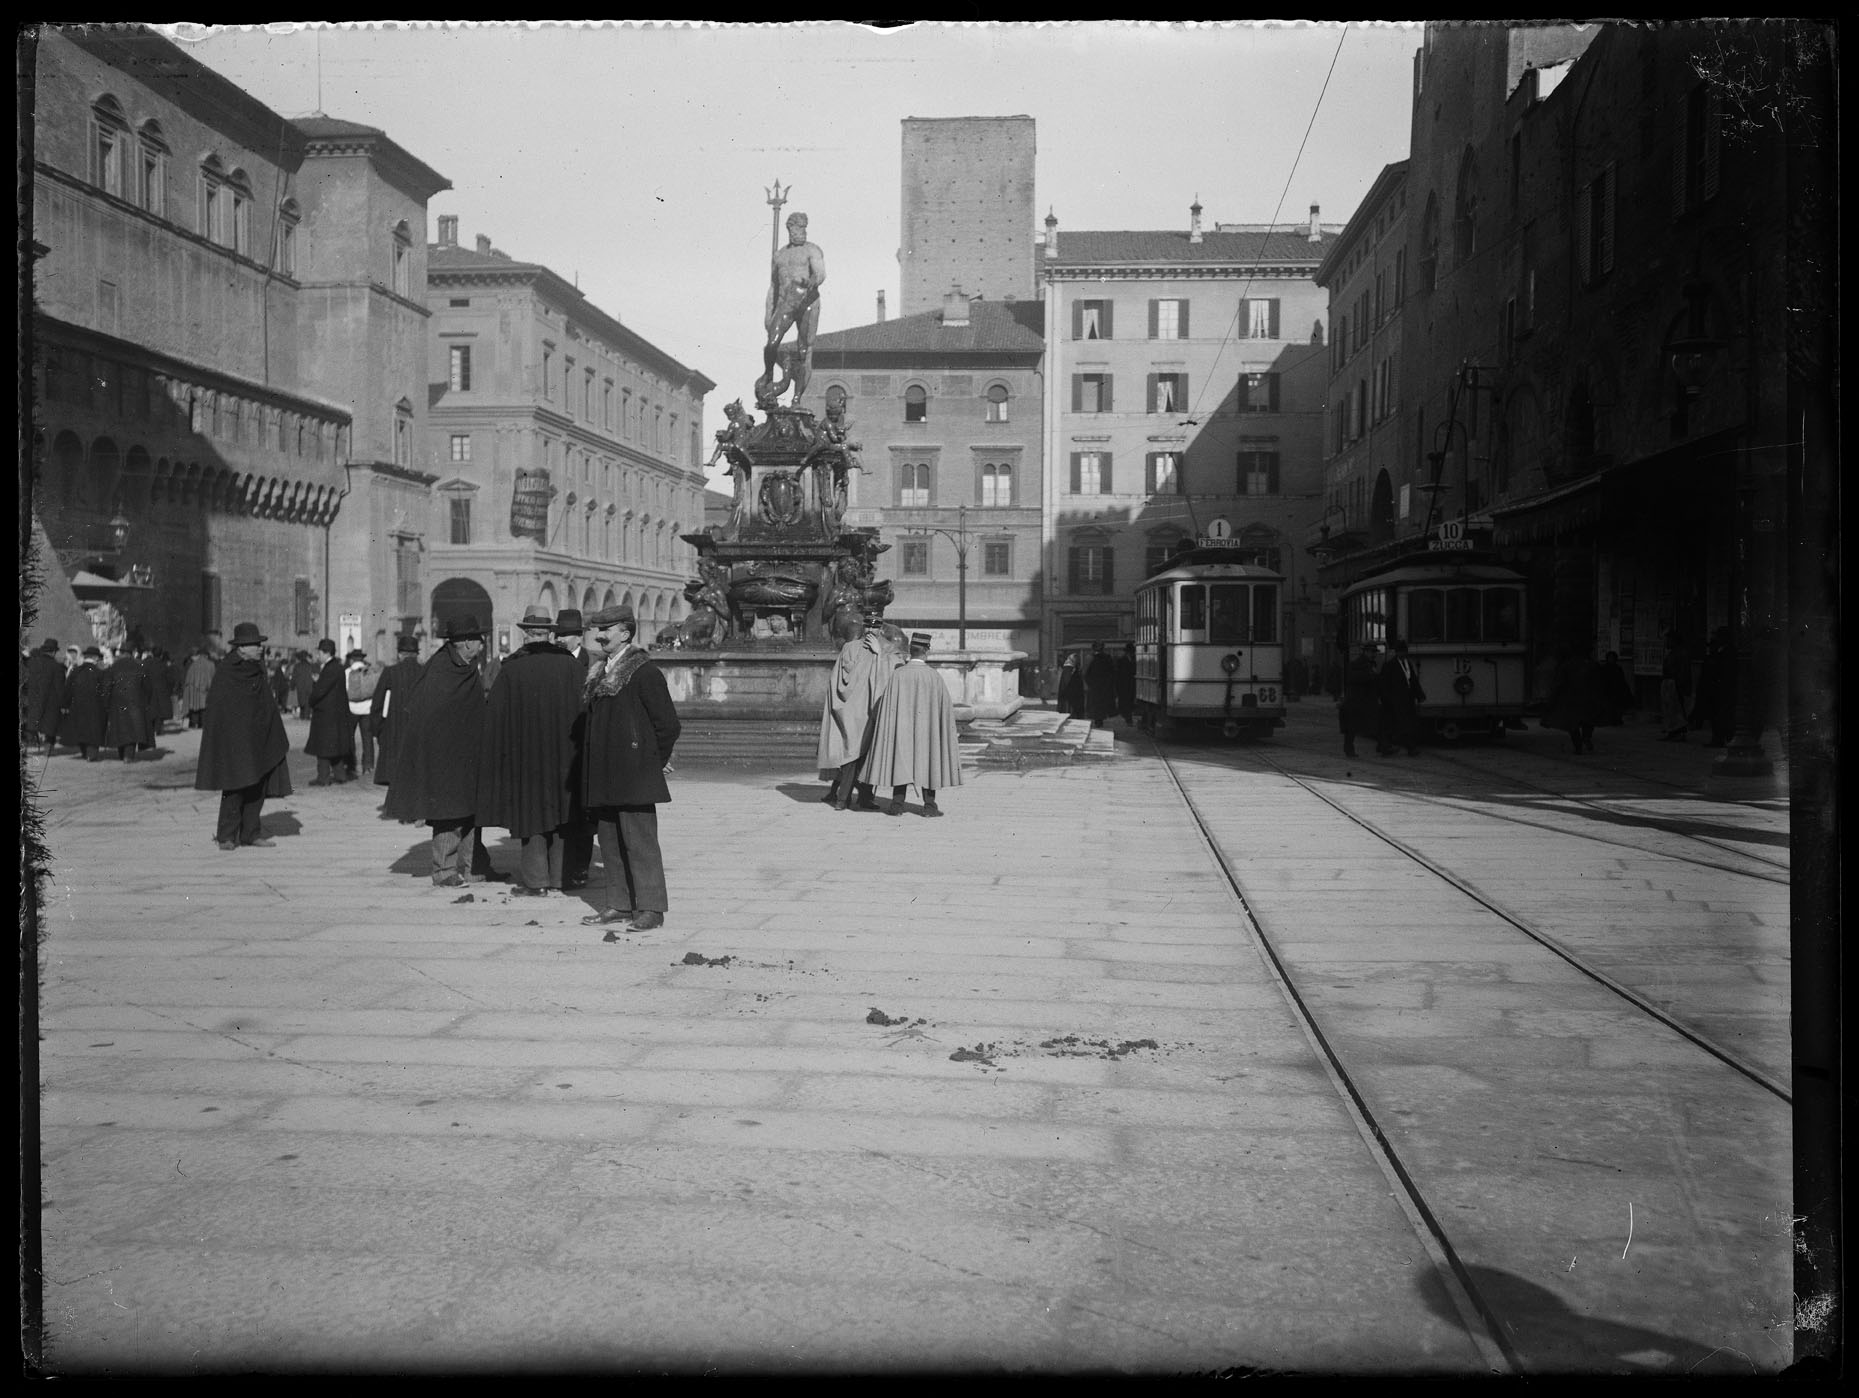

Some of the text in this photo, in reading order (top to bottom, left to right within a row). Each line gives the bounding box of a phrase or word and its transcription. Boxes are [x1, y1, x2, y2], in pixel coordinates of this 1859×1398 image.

[1216, 521, 1223, 537] 1
[1443, 523, 1460, 539] 10
[1200, 538, 1239, 547] FERROVIA
[1432, 541, 1470, 551] ZUCCA
